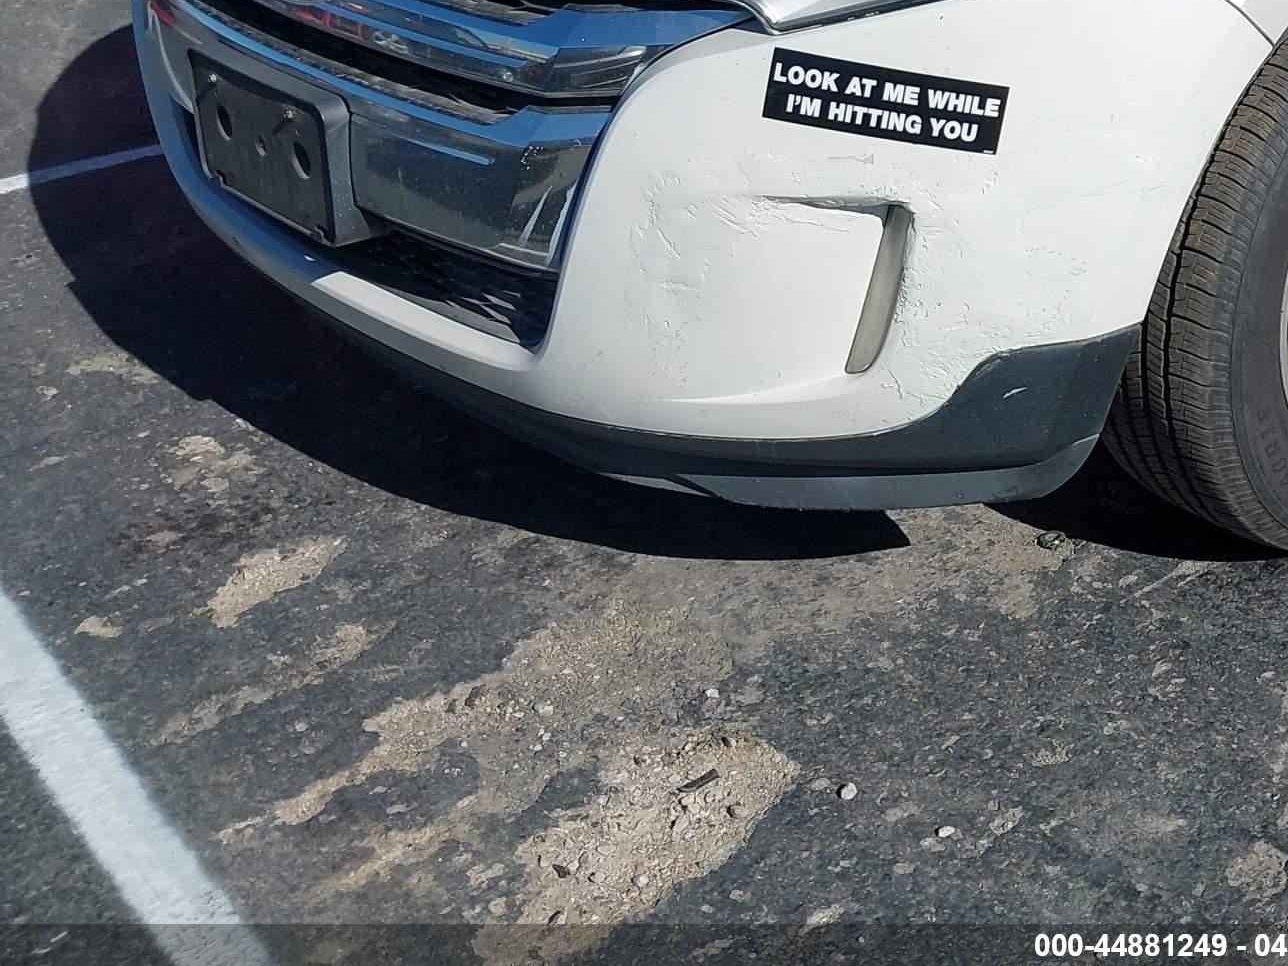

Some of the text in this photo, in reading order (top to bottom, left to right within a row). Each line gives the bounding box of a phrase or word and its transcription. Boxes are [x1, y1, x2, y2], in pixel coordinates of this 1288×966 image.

[773, 62, 1001, 118] LOOK AT ME WHILE
[786, 93, 979, 143] I'M HITTING YOU
